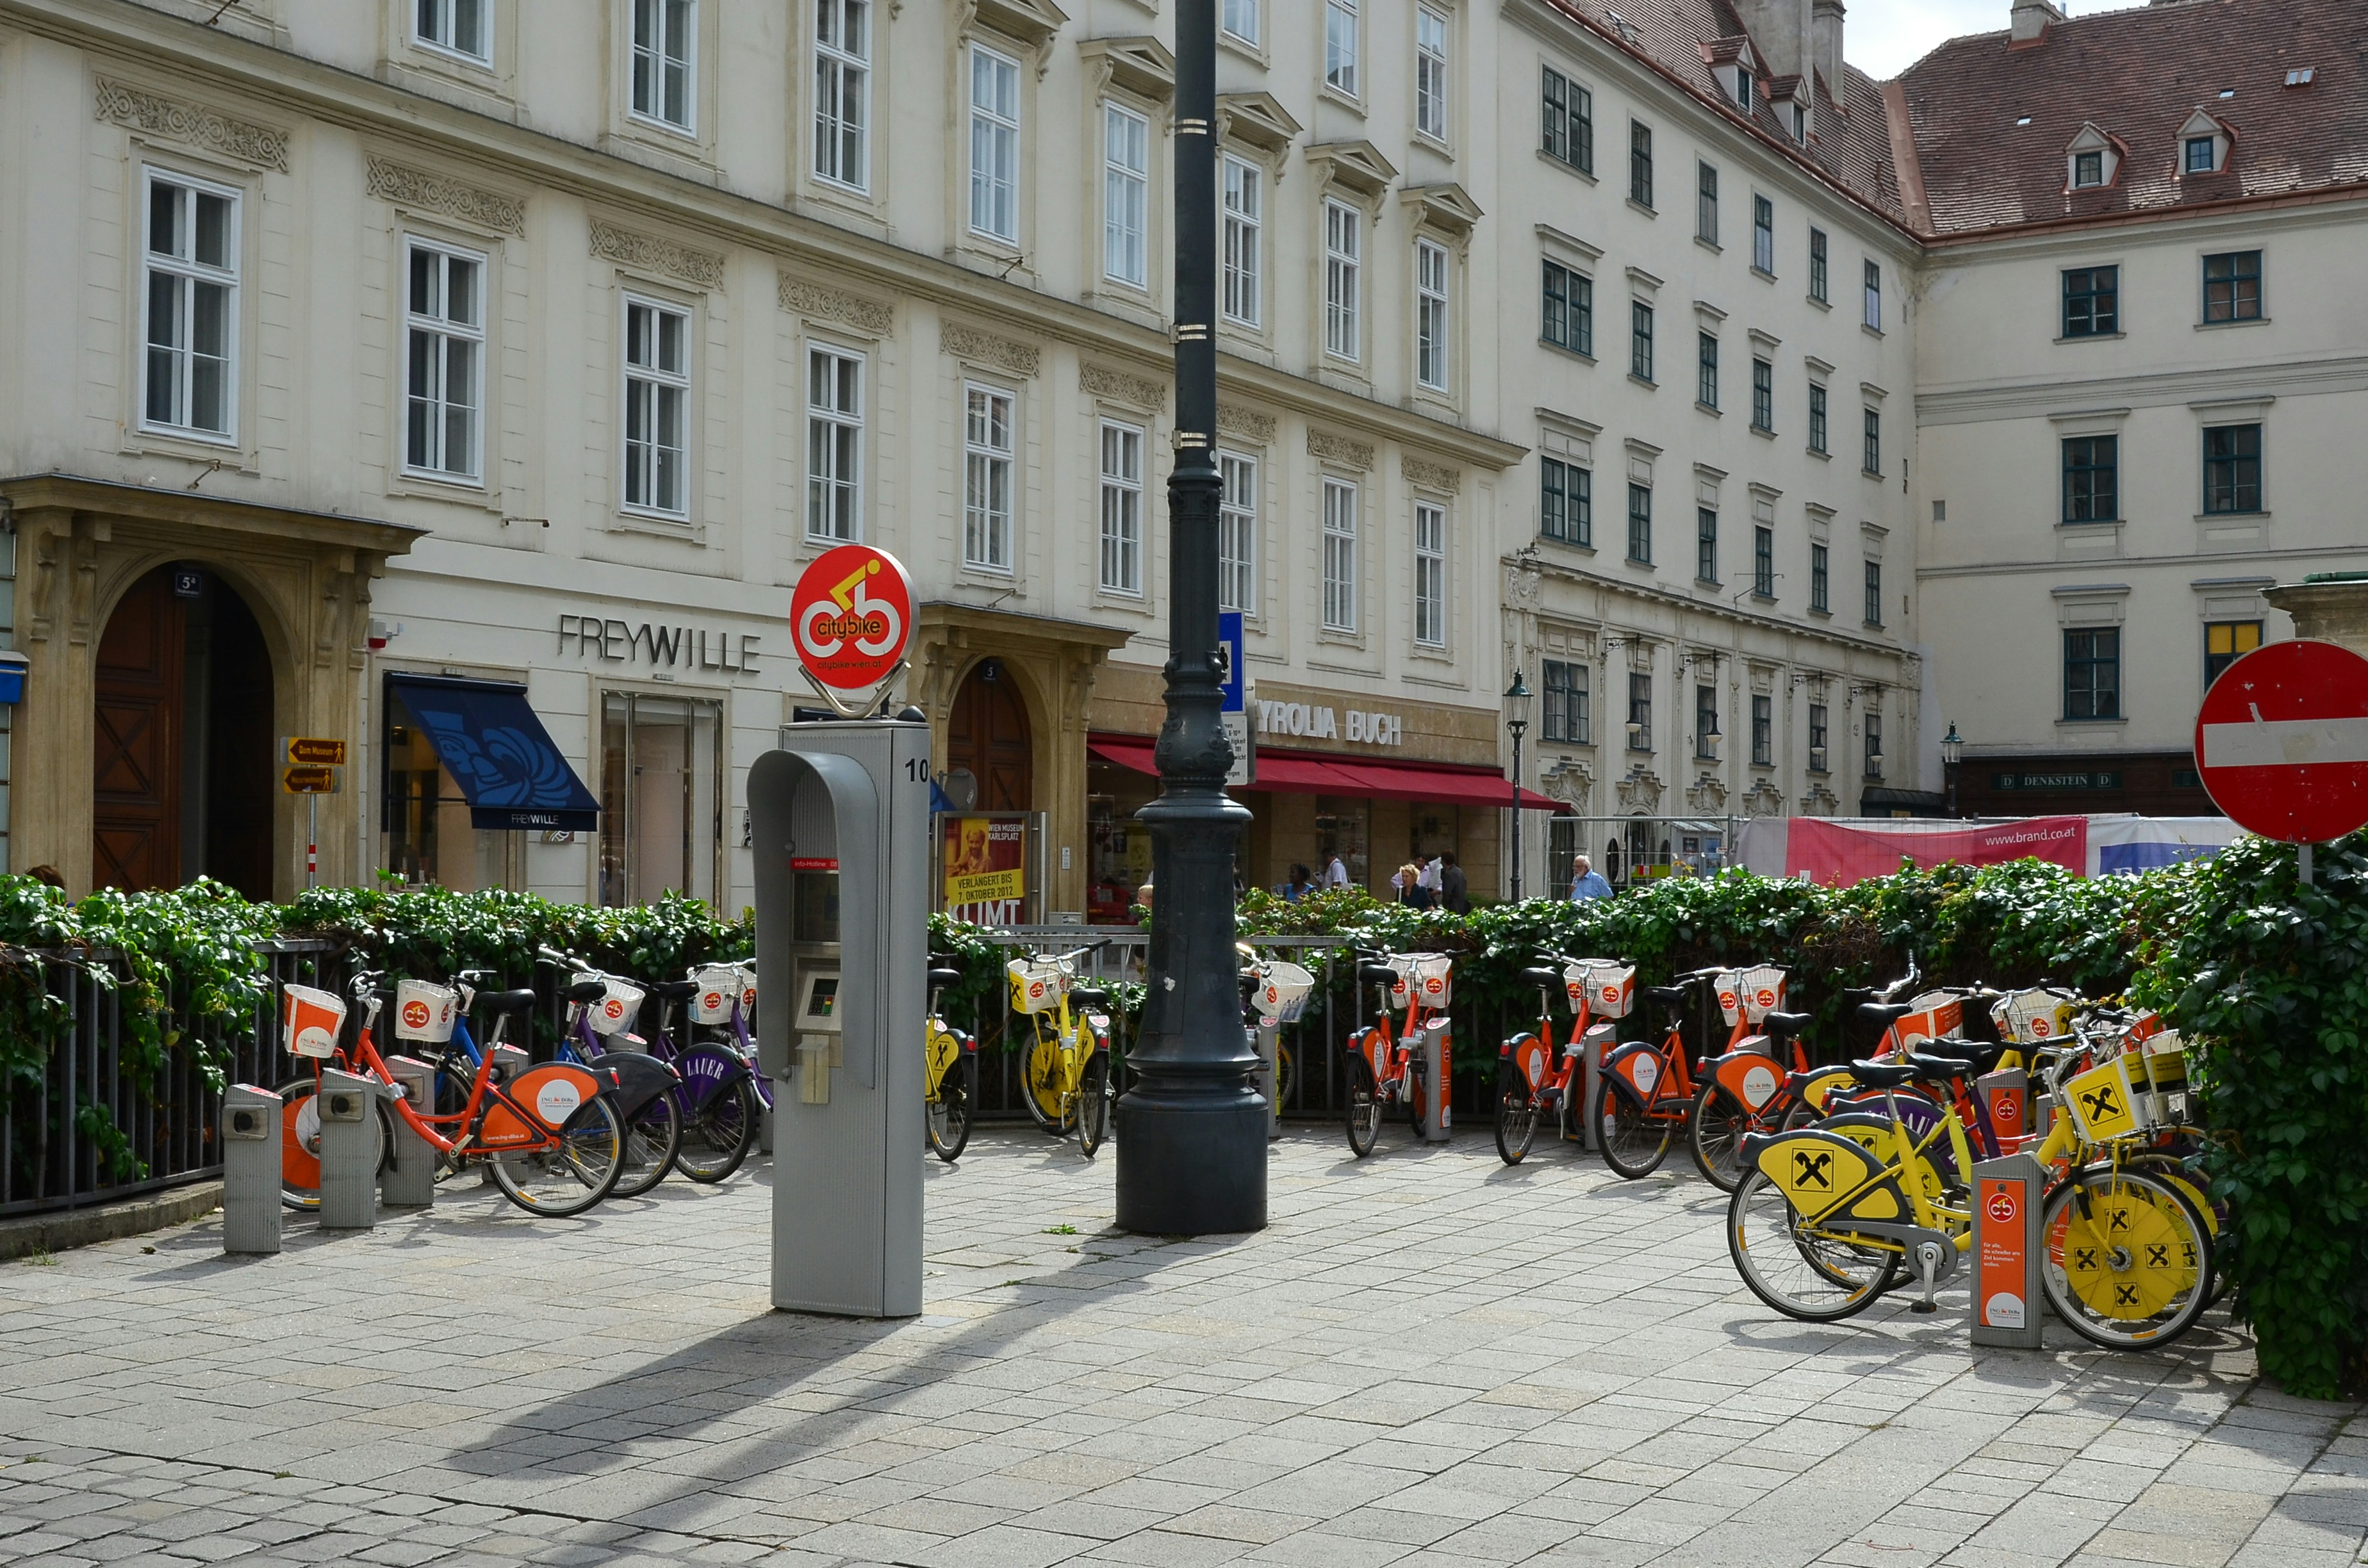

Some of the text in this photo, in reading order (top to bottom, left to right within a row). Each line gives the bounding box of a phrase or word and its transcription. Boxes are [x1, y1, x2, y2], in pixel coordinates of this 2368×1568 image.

[817, 615, 881, 639] citybike
[558, 614, 761, 673] FREYWILLE
[987, 667, 994, 677] 5
[1254, 699, 1401, 746] YROLIA BUCH
[299, 745, 334, 756] Dom Museum
[905, 758, 930, 783] 10
[2024, 775, 2088, 786] DENKSTEIN
[511, 813, 559, 825] FREYWILLE
[988, 823, 1024, 832] WIEN MUSEUM
[1986, 826, 2076, 845] www.brand.co.at
[988, 832, 1019, 841] KARLSPLATZ
[957, 873, 1012, 889] VERLÄNGERT BIS
[958, 885, 1014, 902] 7. OKTOBER 2012
[686, 1058, 725, 1081] LAUER
